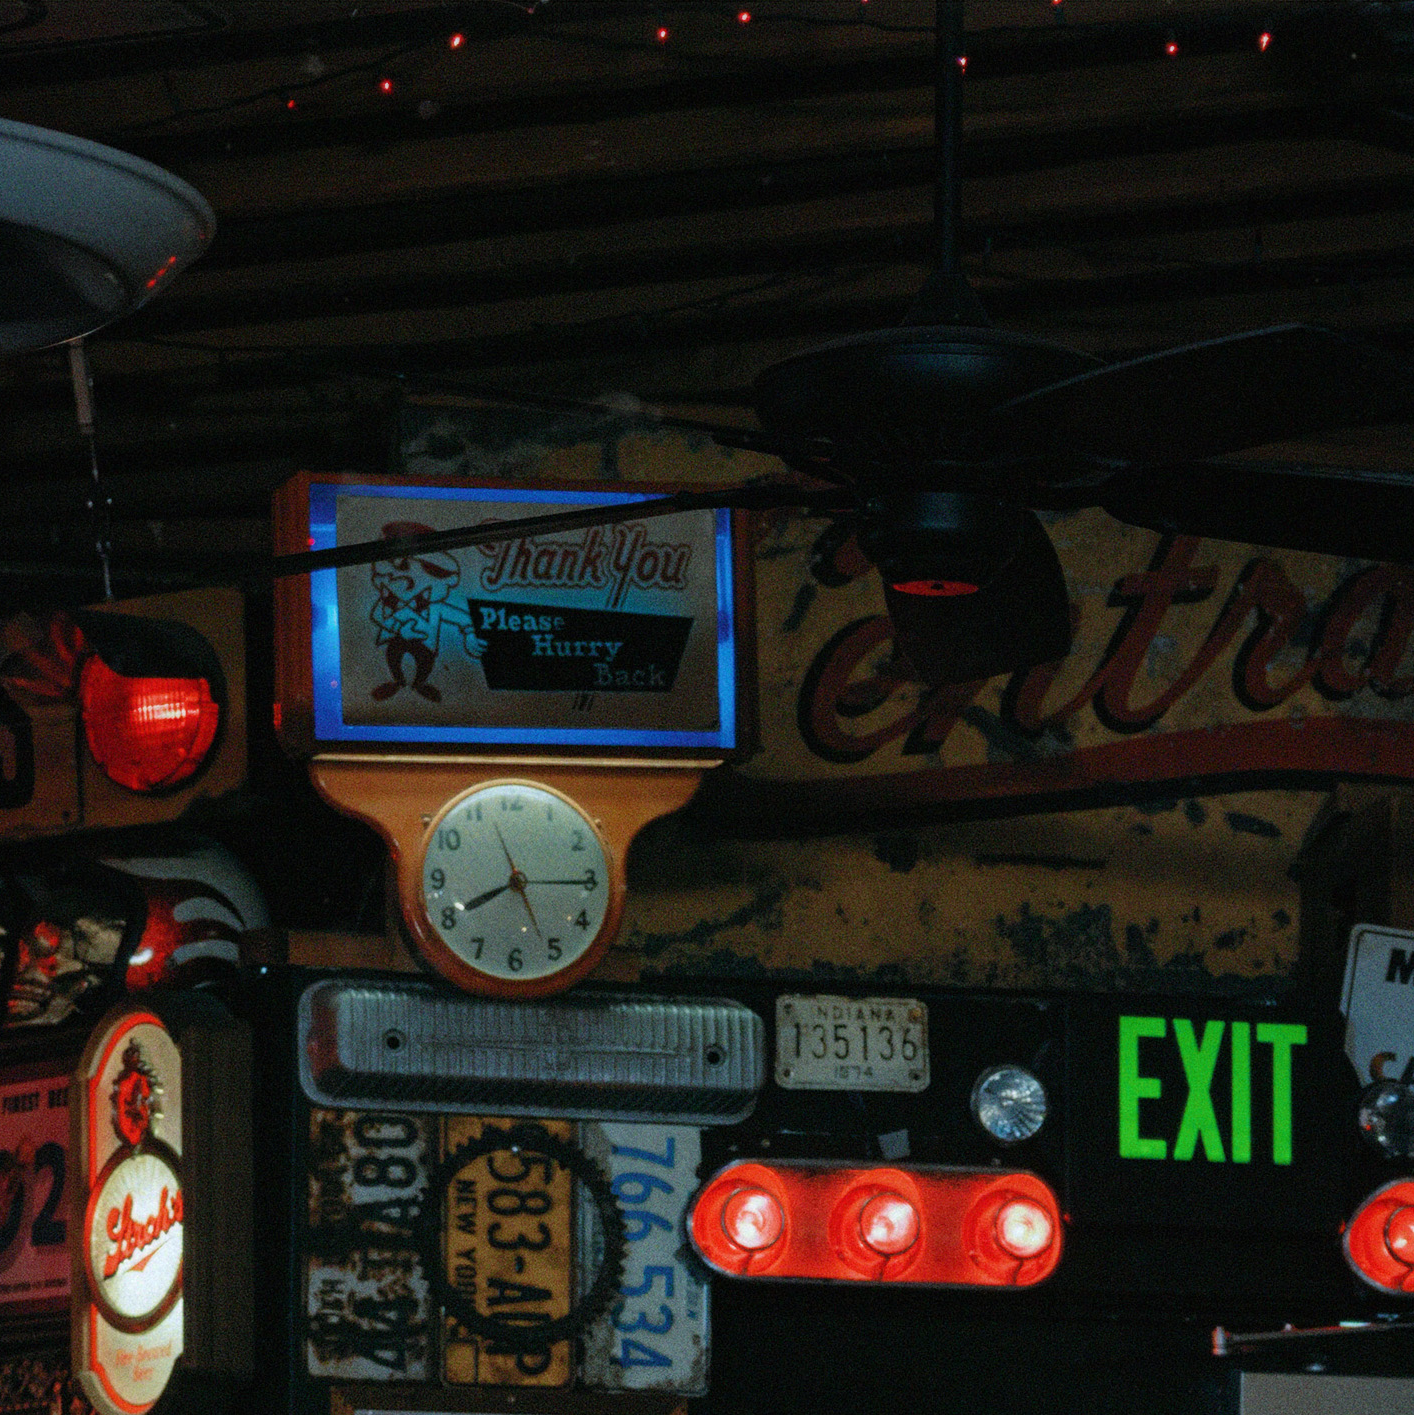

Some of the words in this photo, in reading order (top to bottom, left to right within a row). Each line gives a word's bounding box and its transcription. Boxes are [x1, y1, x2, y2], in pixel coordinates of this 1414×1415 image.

[478, 518, 611, 594] Thank
[609, 524, 694, 608] You
[479, 606, 565, 633] Please
[532, 632, 624, 662] Hurry
[593, 662, 667, 688] Back
[438, 829, 462, 852] 10
[571, 830, 585, 852] 2
[430, 869, 446, 891] 9
[440, 907, 457, 930] 8
[574, 909, 590, 931] 4
[471, 938, 485, 961] 7
[508, 947, 524, 972] 6
[547, 938, 563, 962] 5
[795, 1021, 919, 1063] 135136
[1118, 1015, 1308, 1167] EXIT
[455, 1179, 478, 1235] NEW
[609, 1264, 675, 1369] 534
